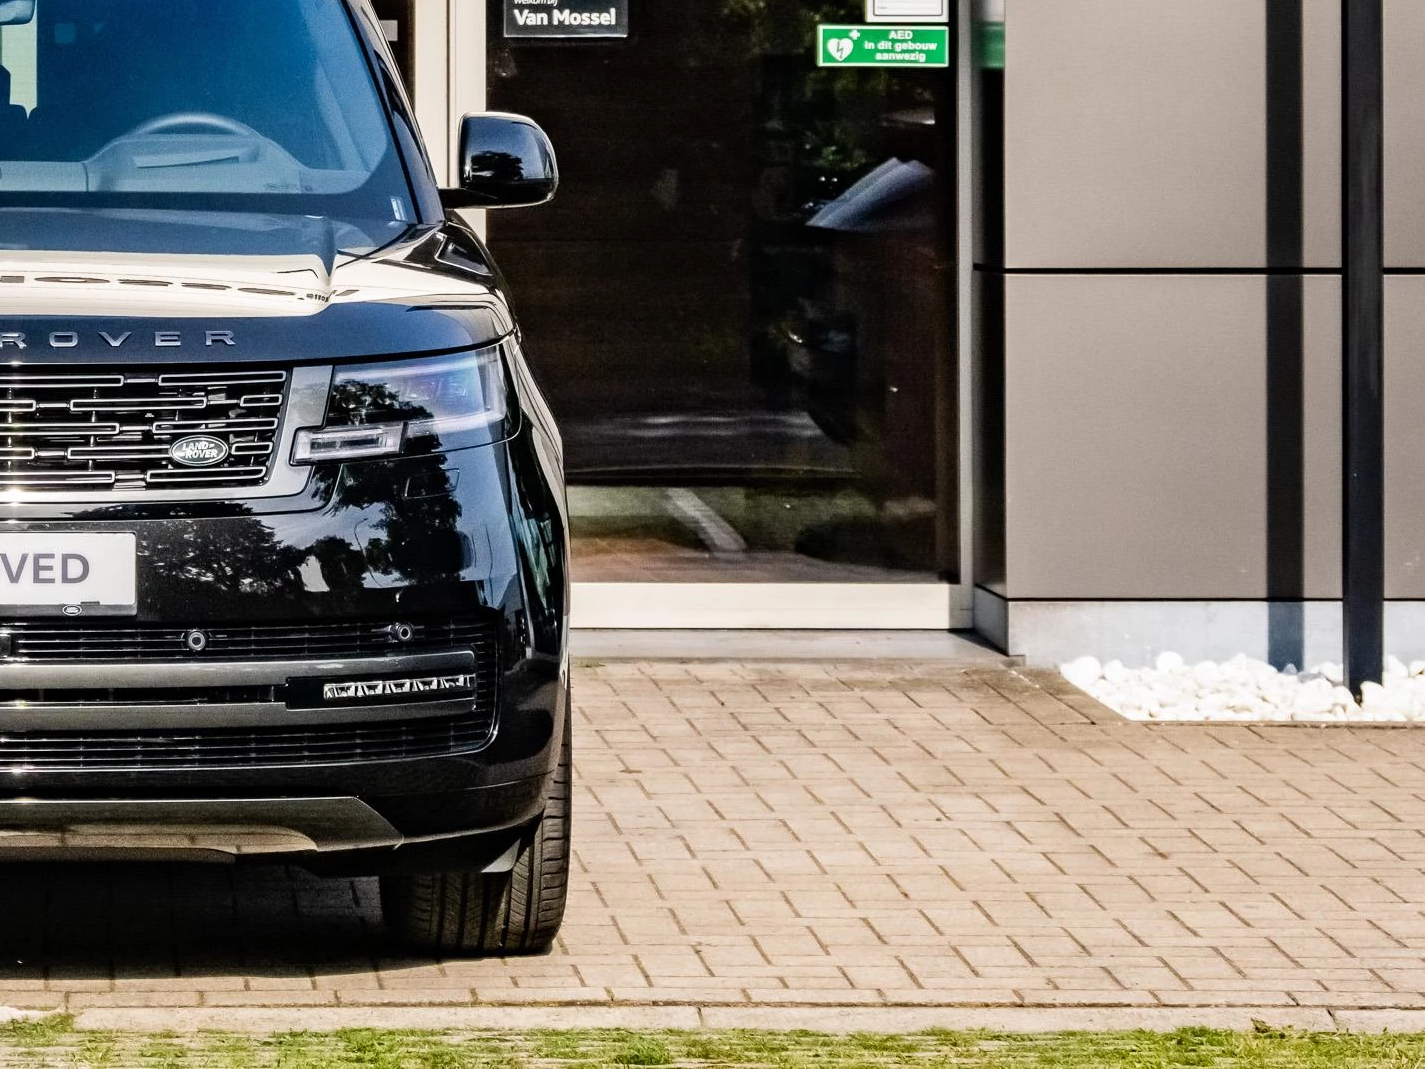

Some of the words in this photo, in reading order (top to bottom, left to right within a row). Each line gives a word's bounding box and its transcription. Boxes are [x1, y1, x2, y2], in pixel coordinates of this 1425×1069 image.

[513, 9, 548, 25] Van
[552, 7, 617, 25] Mossel
[889, 30, 913, 40] AED
[878, 41, 892, 50] dit
[894, 41, 938, 52] gebouw
[875, 51, 927, 63] aanwezig
[182, 441, 209, 450] LAND
[185, 449, 218, 459] ROVER
